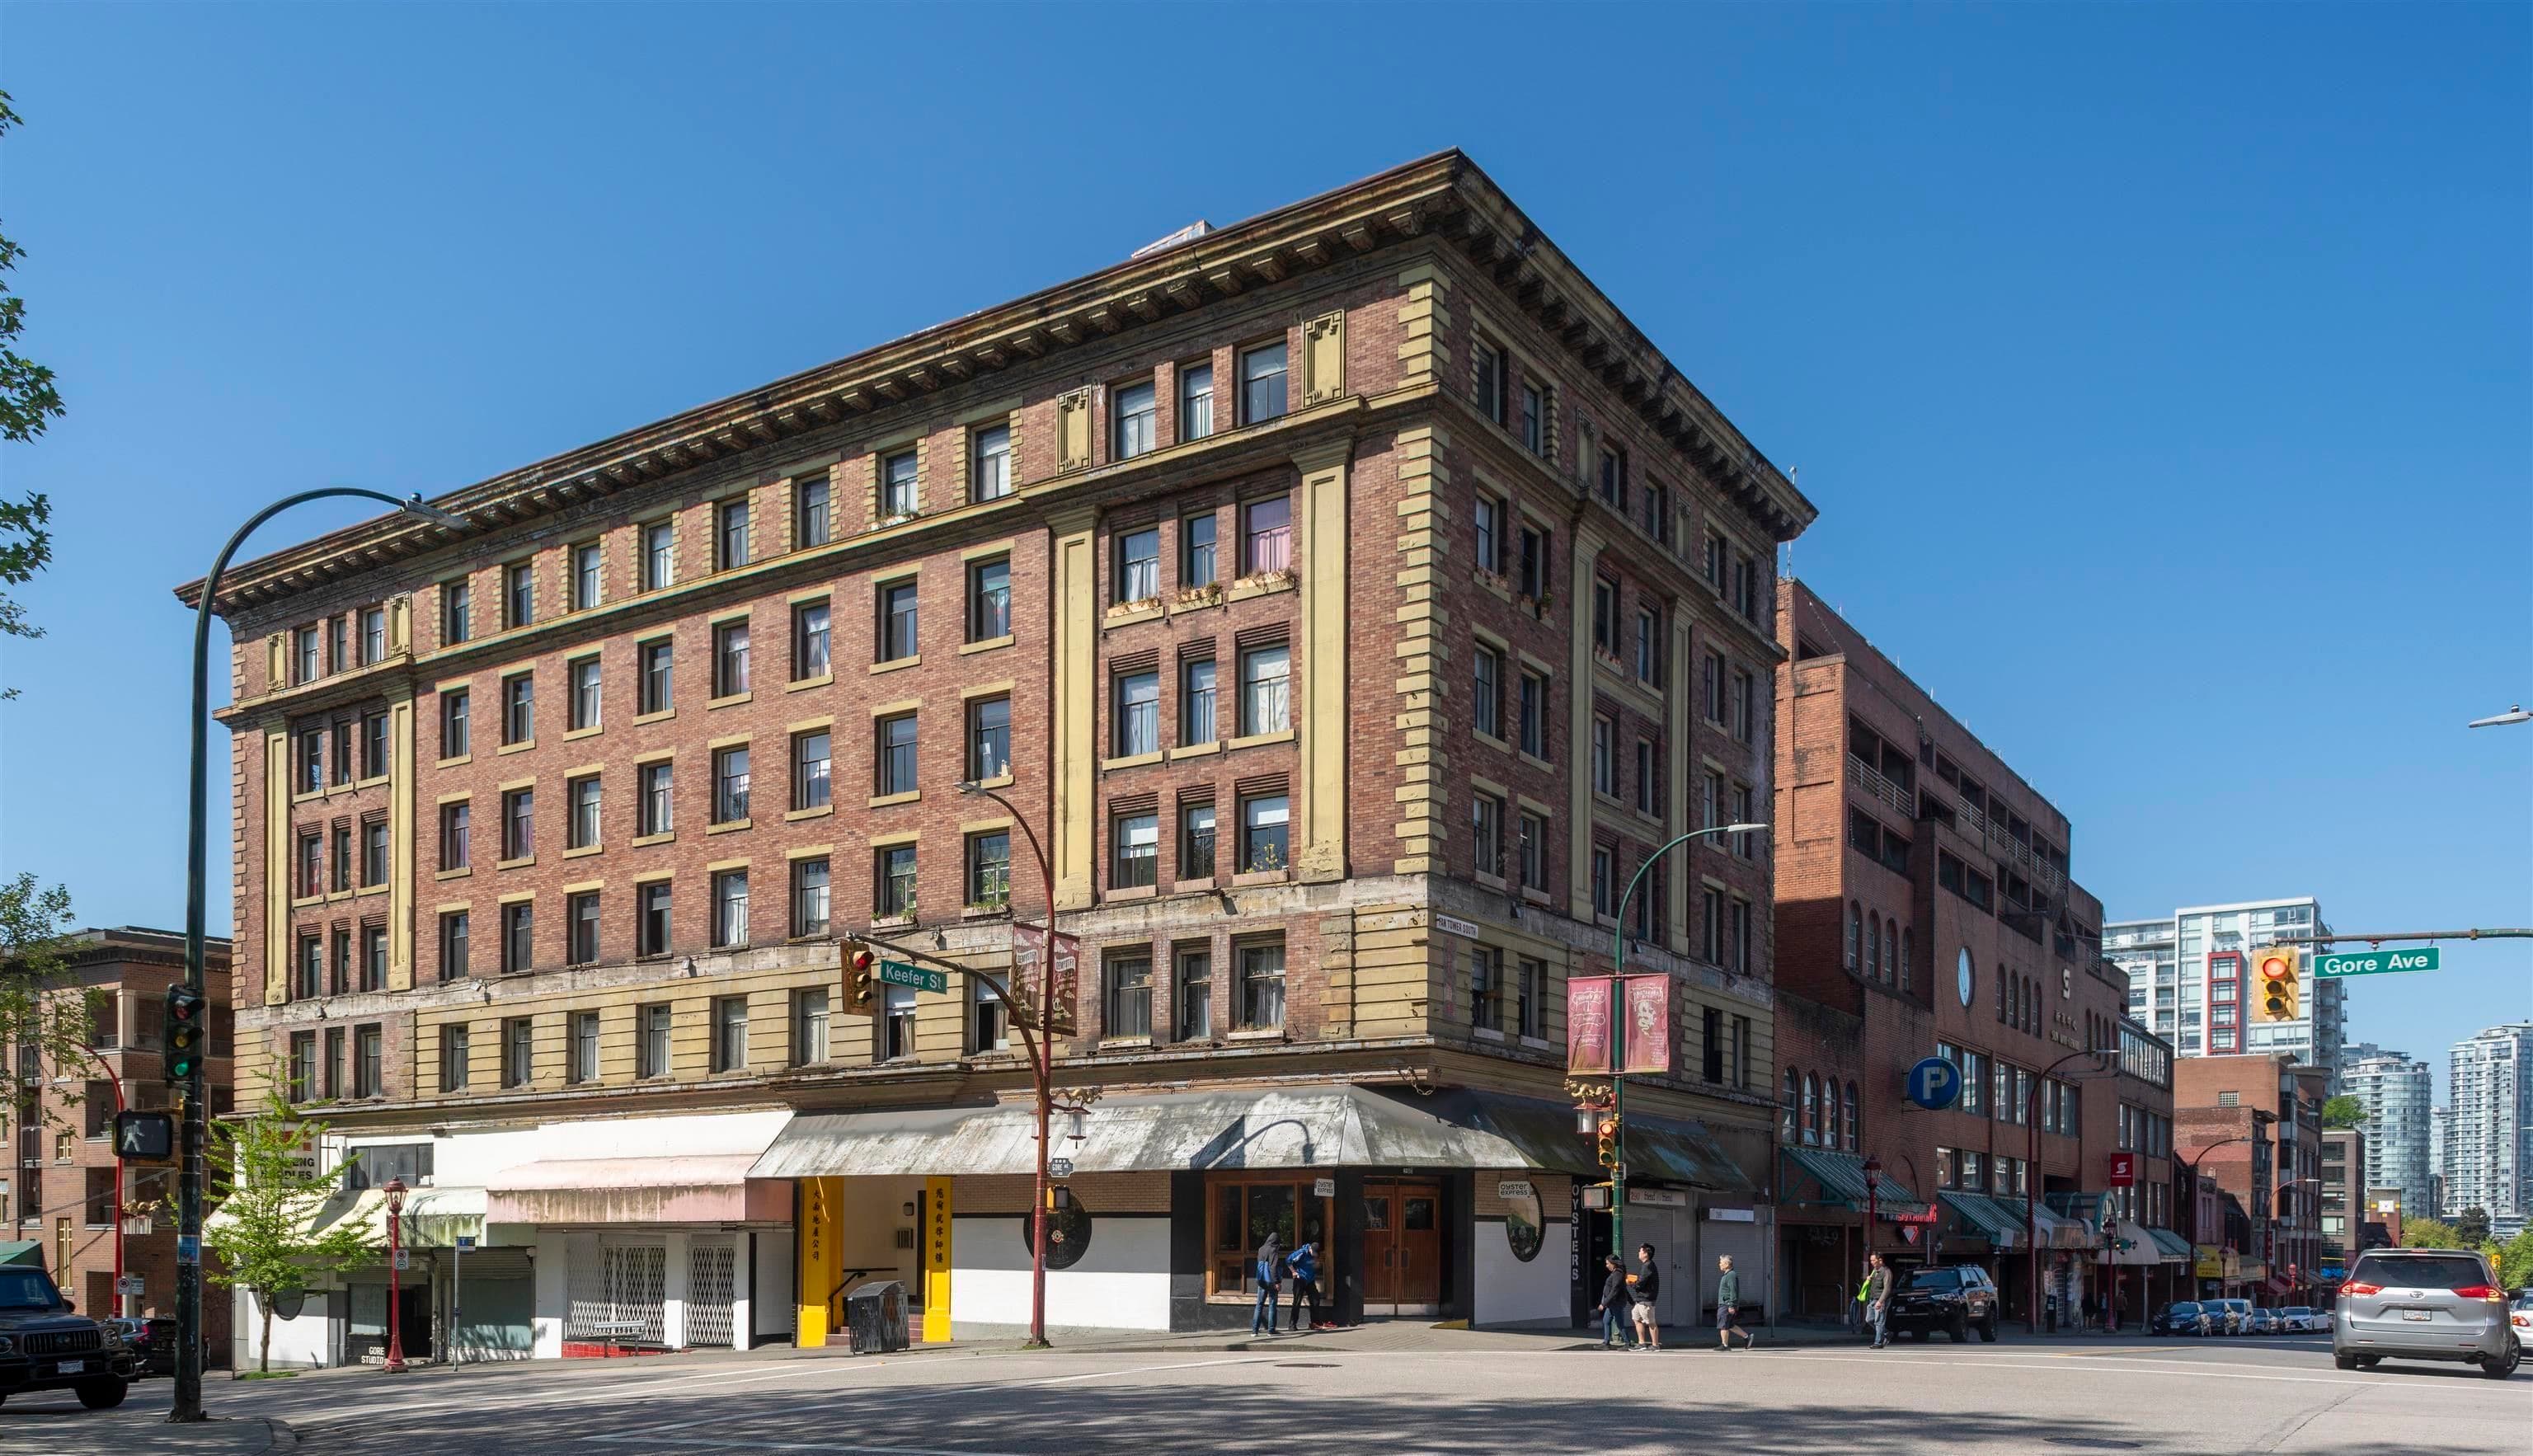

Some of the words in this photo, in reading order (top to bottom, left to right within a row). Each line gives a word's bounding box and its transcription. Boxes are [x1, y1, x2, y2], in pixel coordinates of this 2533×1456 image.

[2324, 958, 2377, 975] Gore
[2387, 954, 2428, 970] Ave
[886, 964, 924, 986] Keefer
[929, 974, 942, 989] St
[1923, 1067, 1950, 1100] P
[1572, 1184, 1580, 1280] OYSTERS
[361, 1355, 384, 1364] STUDIO
[369, 1346, 385, 1355] GORE
